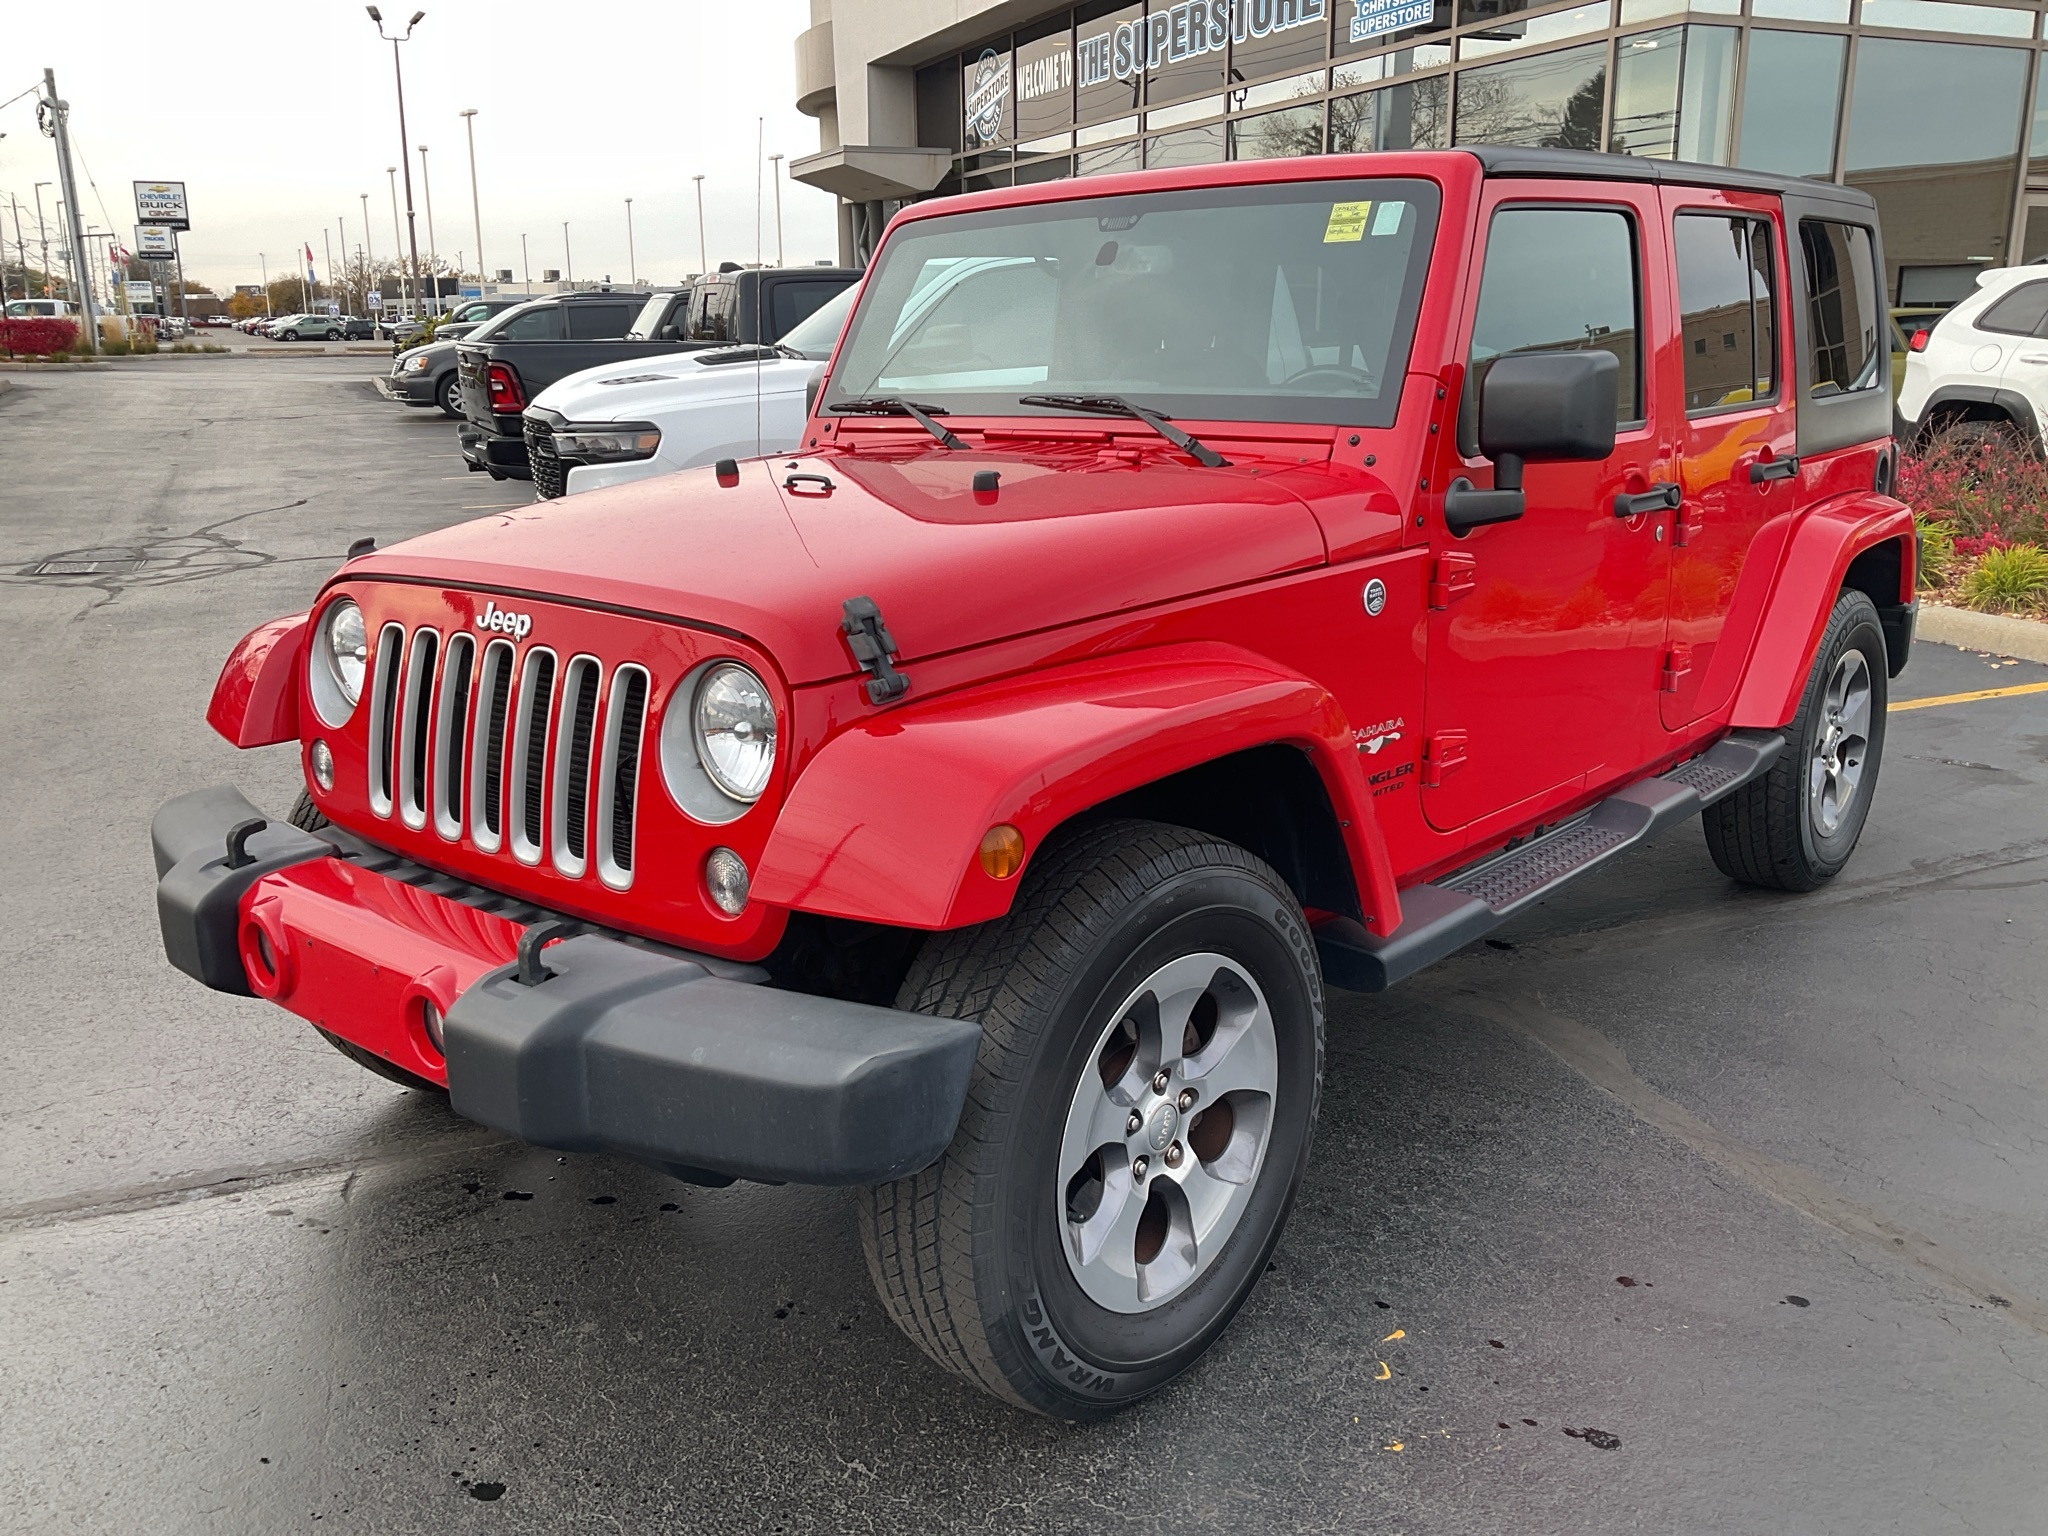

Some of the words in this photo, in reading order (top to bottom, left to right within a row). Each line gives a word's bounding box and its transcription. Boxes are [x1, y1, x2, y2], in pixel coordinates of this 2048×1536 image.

[1353, 2, 1431, 36] SUPERSTORE
[1361, 0, 1416, 16] CHRYS
[975, 55, 997, 84] WINDSOR
[1016, 54, 1059, 102] WELCOME
[1060, 49, 1072, 88] TO
[1078, 32, 1110, 88] THE
[968, 70, 1009, 120] SUPERSTORE
[980, 105, 1001, 135] CHRYSLER
[139, 201, 183, 209] BUICK
[475, 601, 532, 643] Jeep
[1351, 716, 1404, 740] SAHARA
[1157, 1110, 1171, 1146] Jeep
